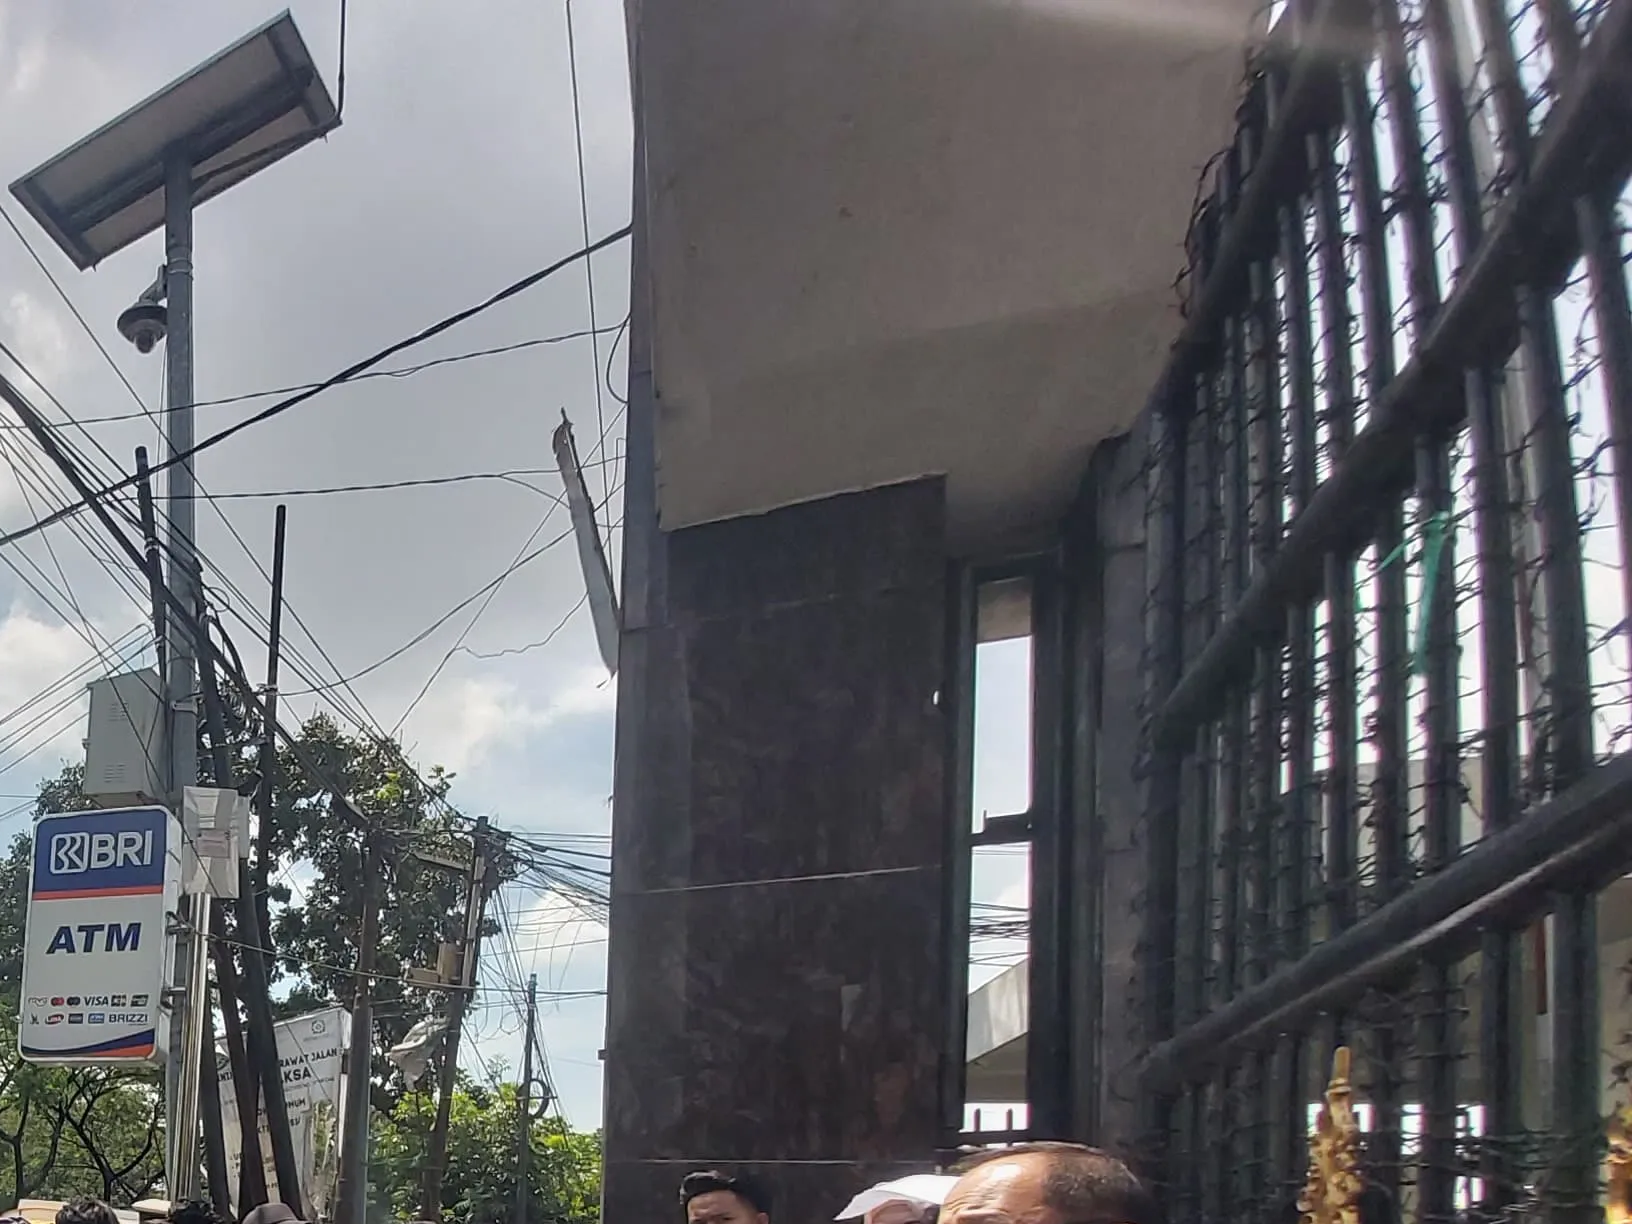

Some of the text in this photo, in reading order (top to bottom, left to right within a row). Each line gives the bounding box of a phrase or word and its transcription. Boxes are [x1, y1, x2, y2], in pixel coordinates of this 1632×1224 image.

[90, 830, 153, 869] BRI
[45, 922, 142, 954] ATM
[84, 996, 109, 1006] VISA
[108, 1013, 148, 1023] BRIZZI
[311, 1047, 337, 1061] JALAN
[281, 1067, 311, 1083] KSA
